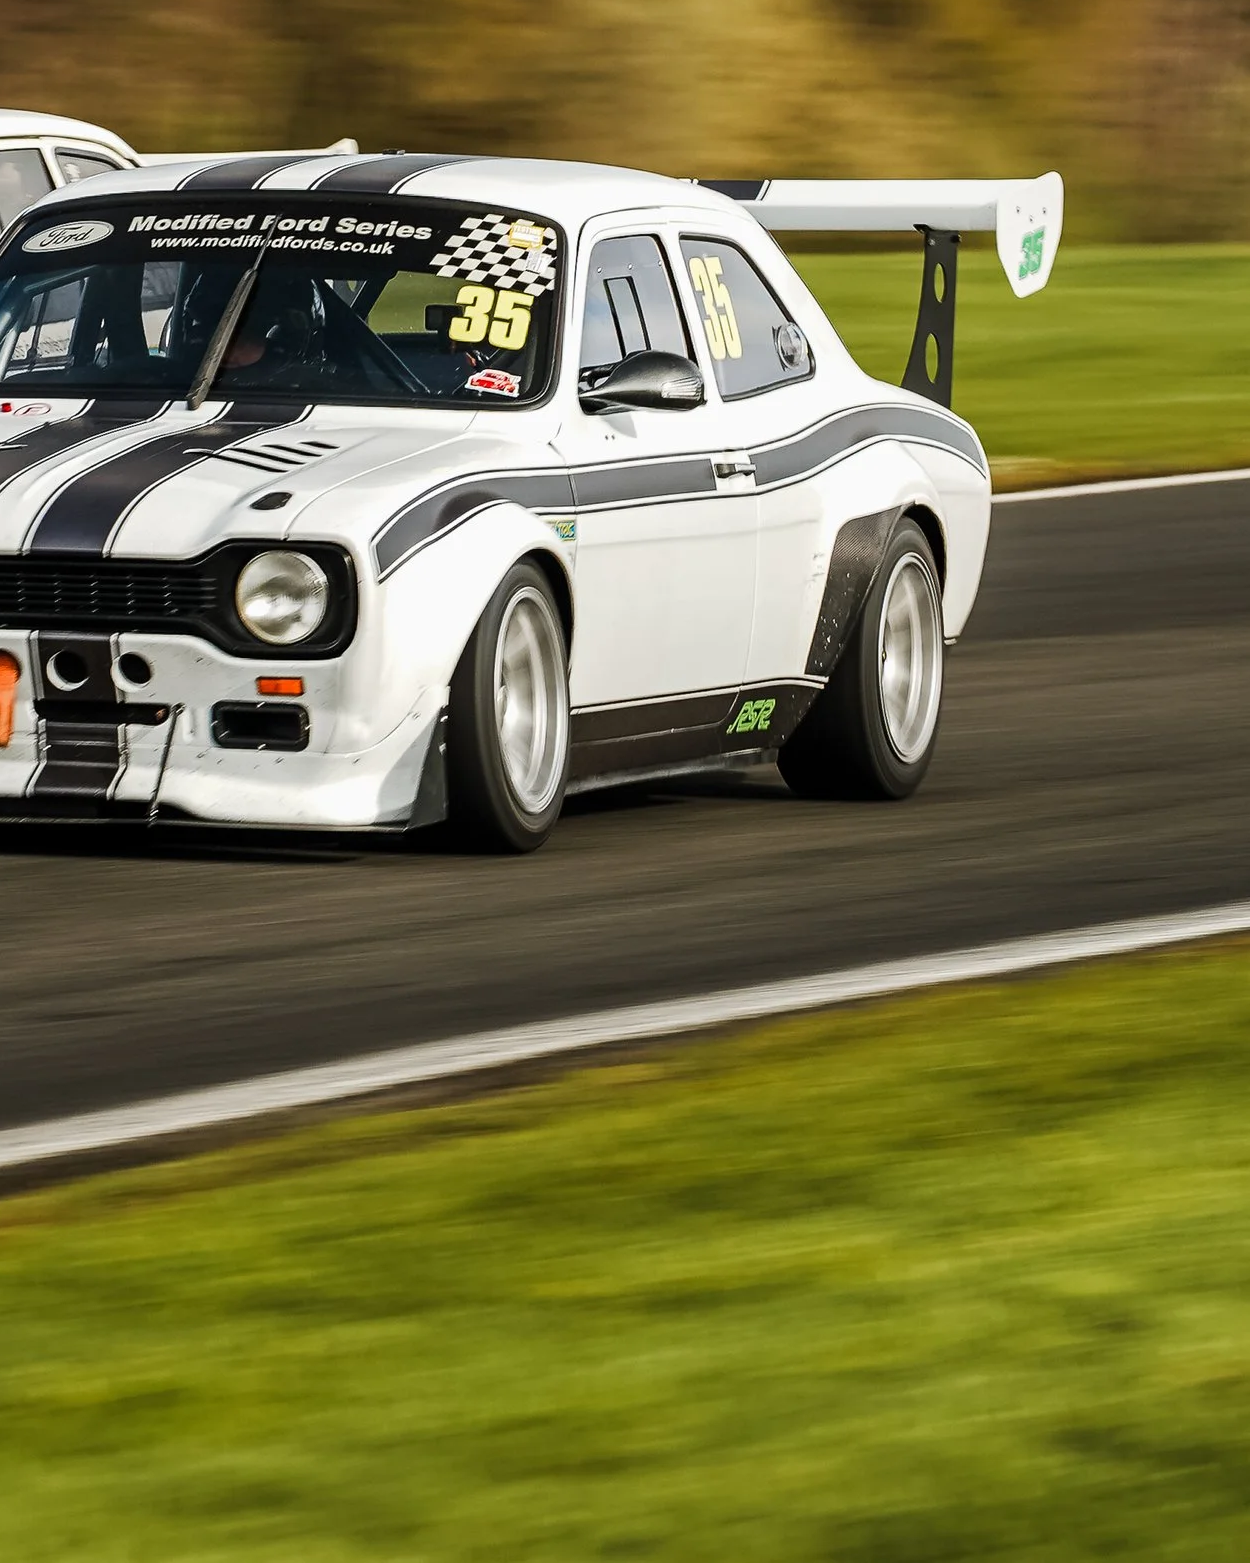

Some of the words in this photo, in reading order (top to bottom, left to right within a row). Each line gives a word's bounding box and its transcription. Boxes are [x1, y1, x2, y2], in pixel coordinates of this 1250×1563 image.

[39, 226, 93, 248] Ford
[128, 214, 255, 232] Modified
[259, 214, 330, 232] Ford
[334, 217, 433, 240] Series
[448, 284, 534, 351] 35
[688, 257, 742, 360] 35
